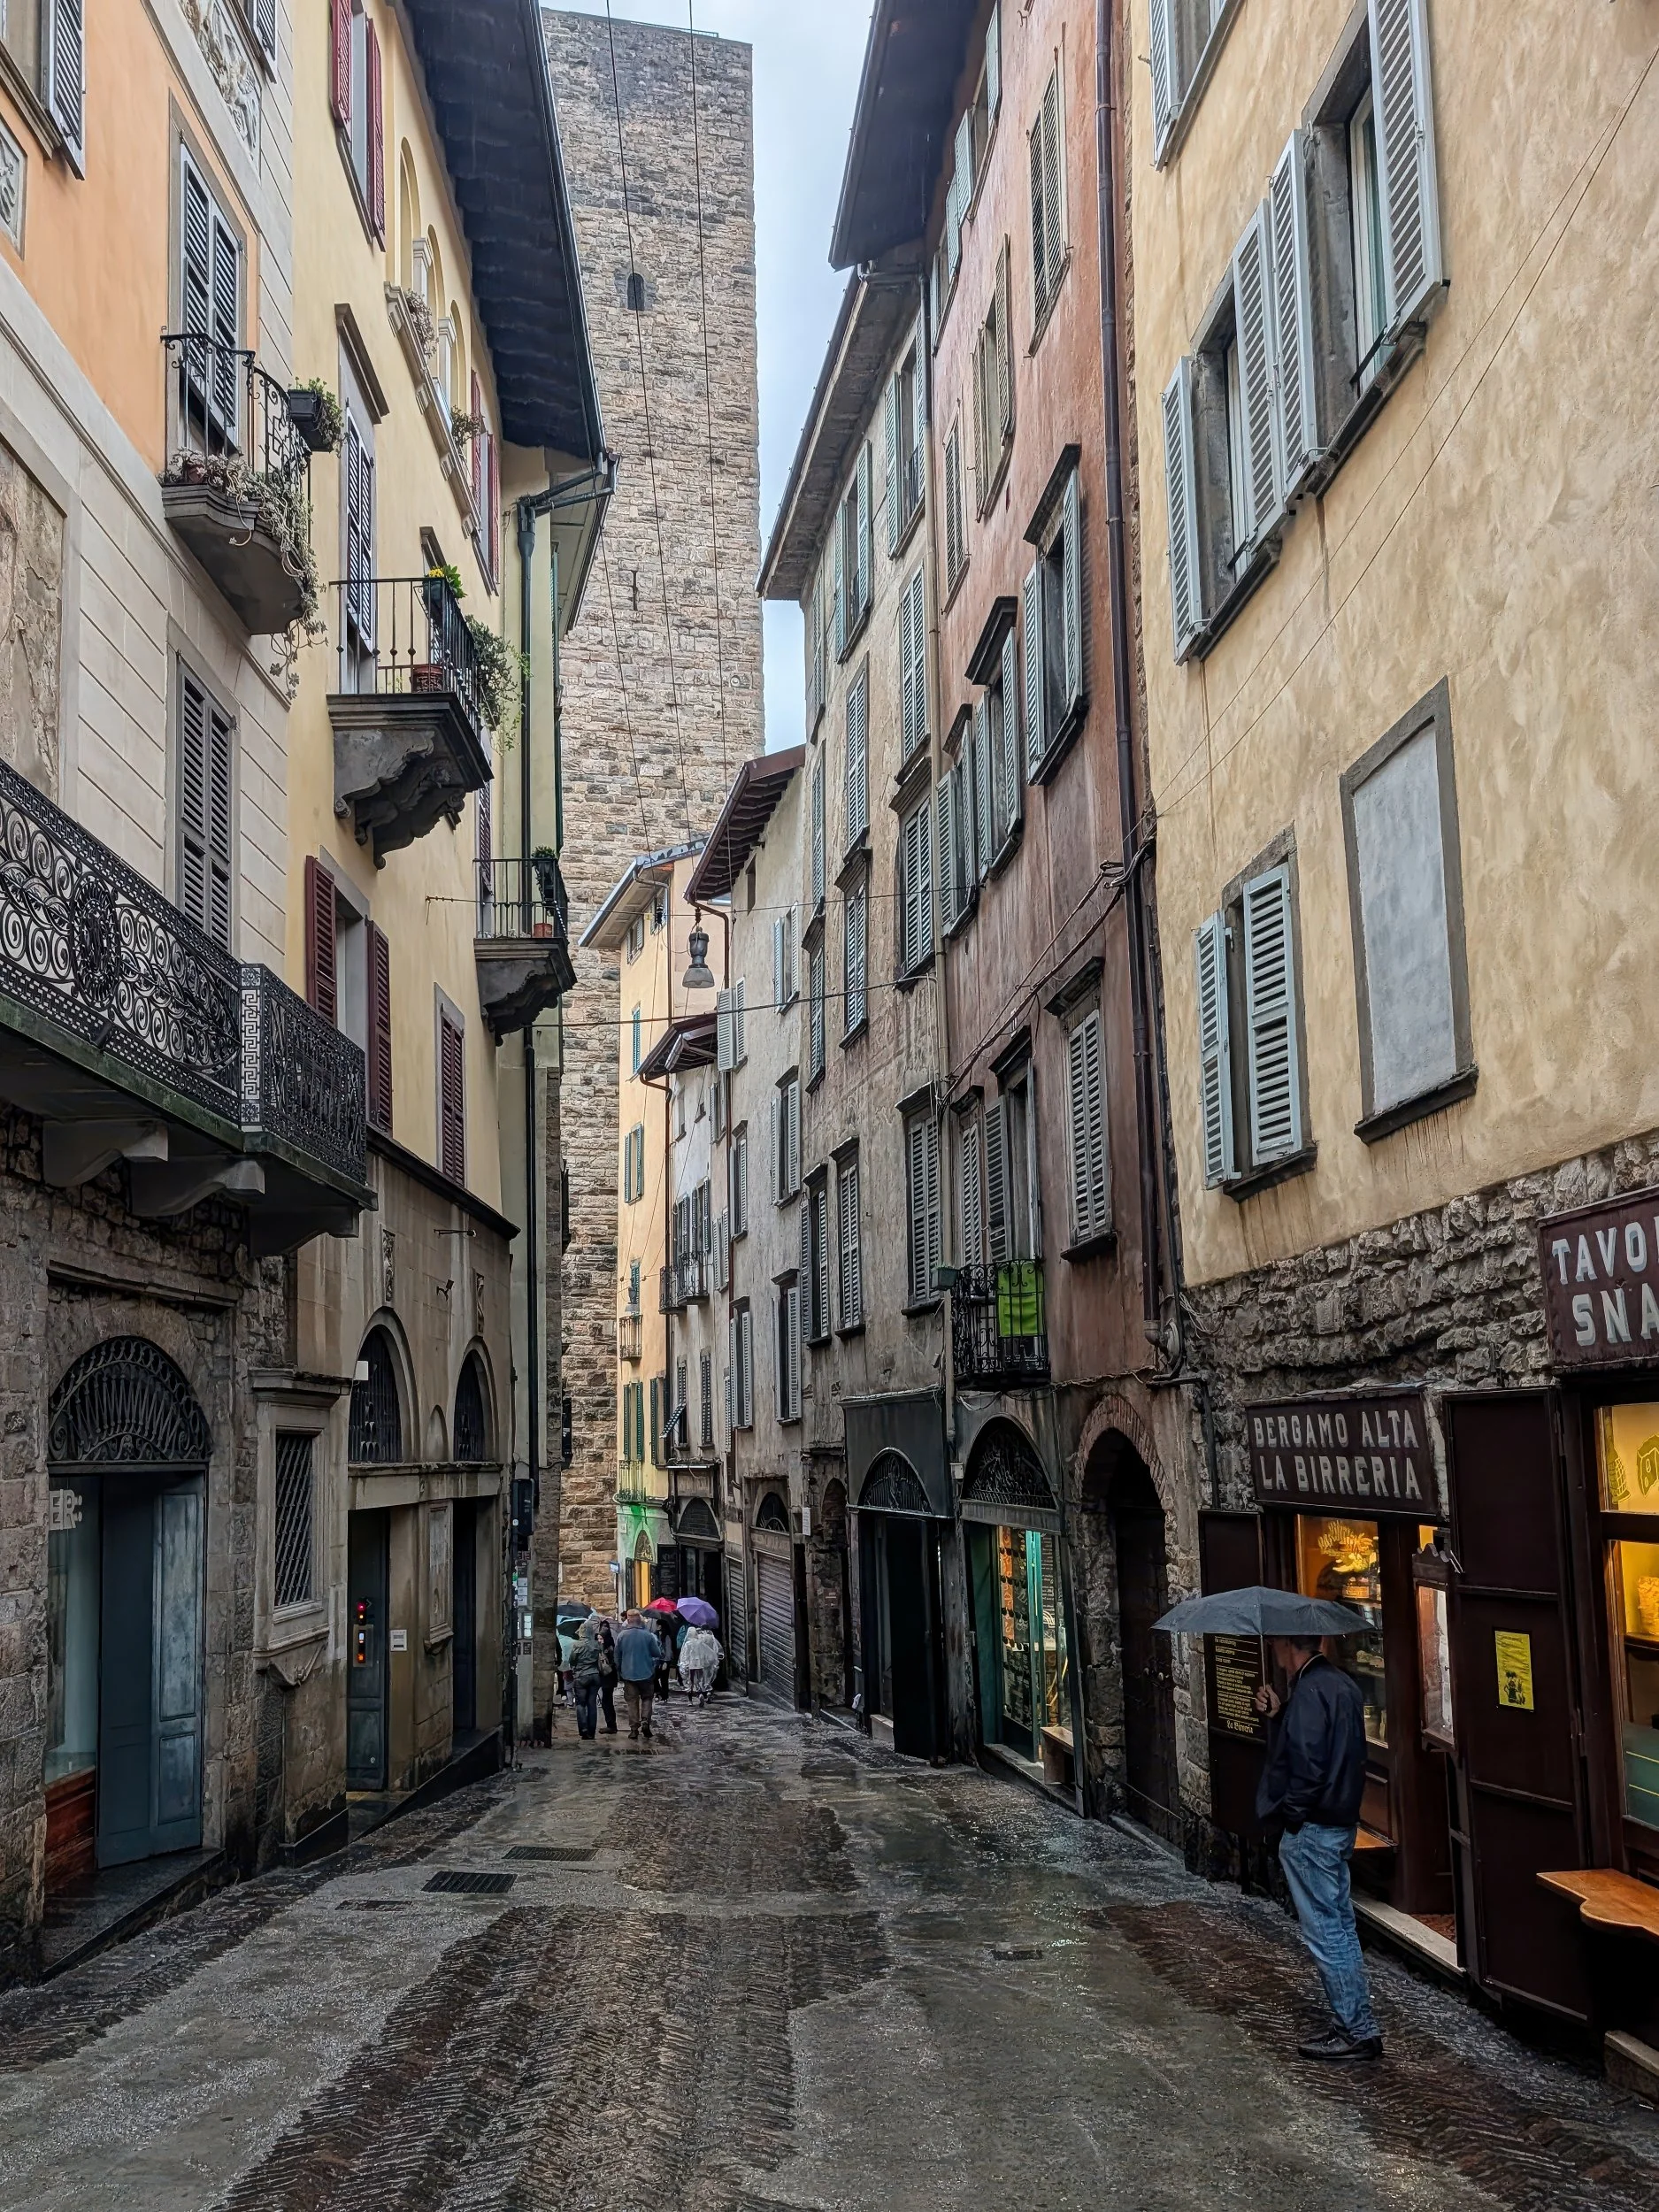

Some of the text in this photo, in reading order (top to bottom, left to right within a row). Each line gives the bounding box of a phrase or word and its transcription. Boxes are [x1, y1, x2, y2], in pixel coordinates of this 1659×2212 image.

[1552, 1216, 1659, 1285] TAVO
[1254, 1409, 1419, 1448] BERGAMO ALTA
[1260, 1455, 1424, 1501] LA BIRRERIA
